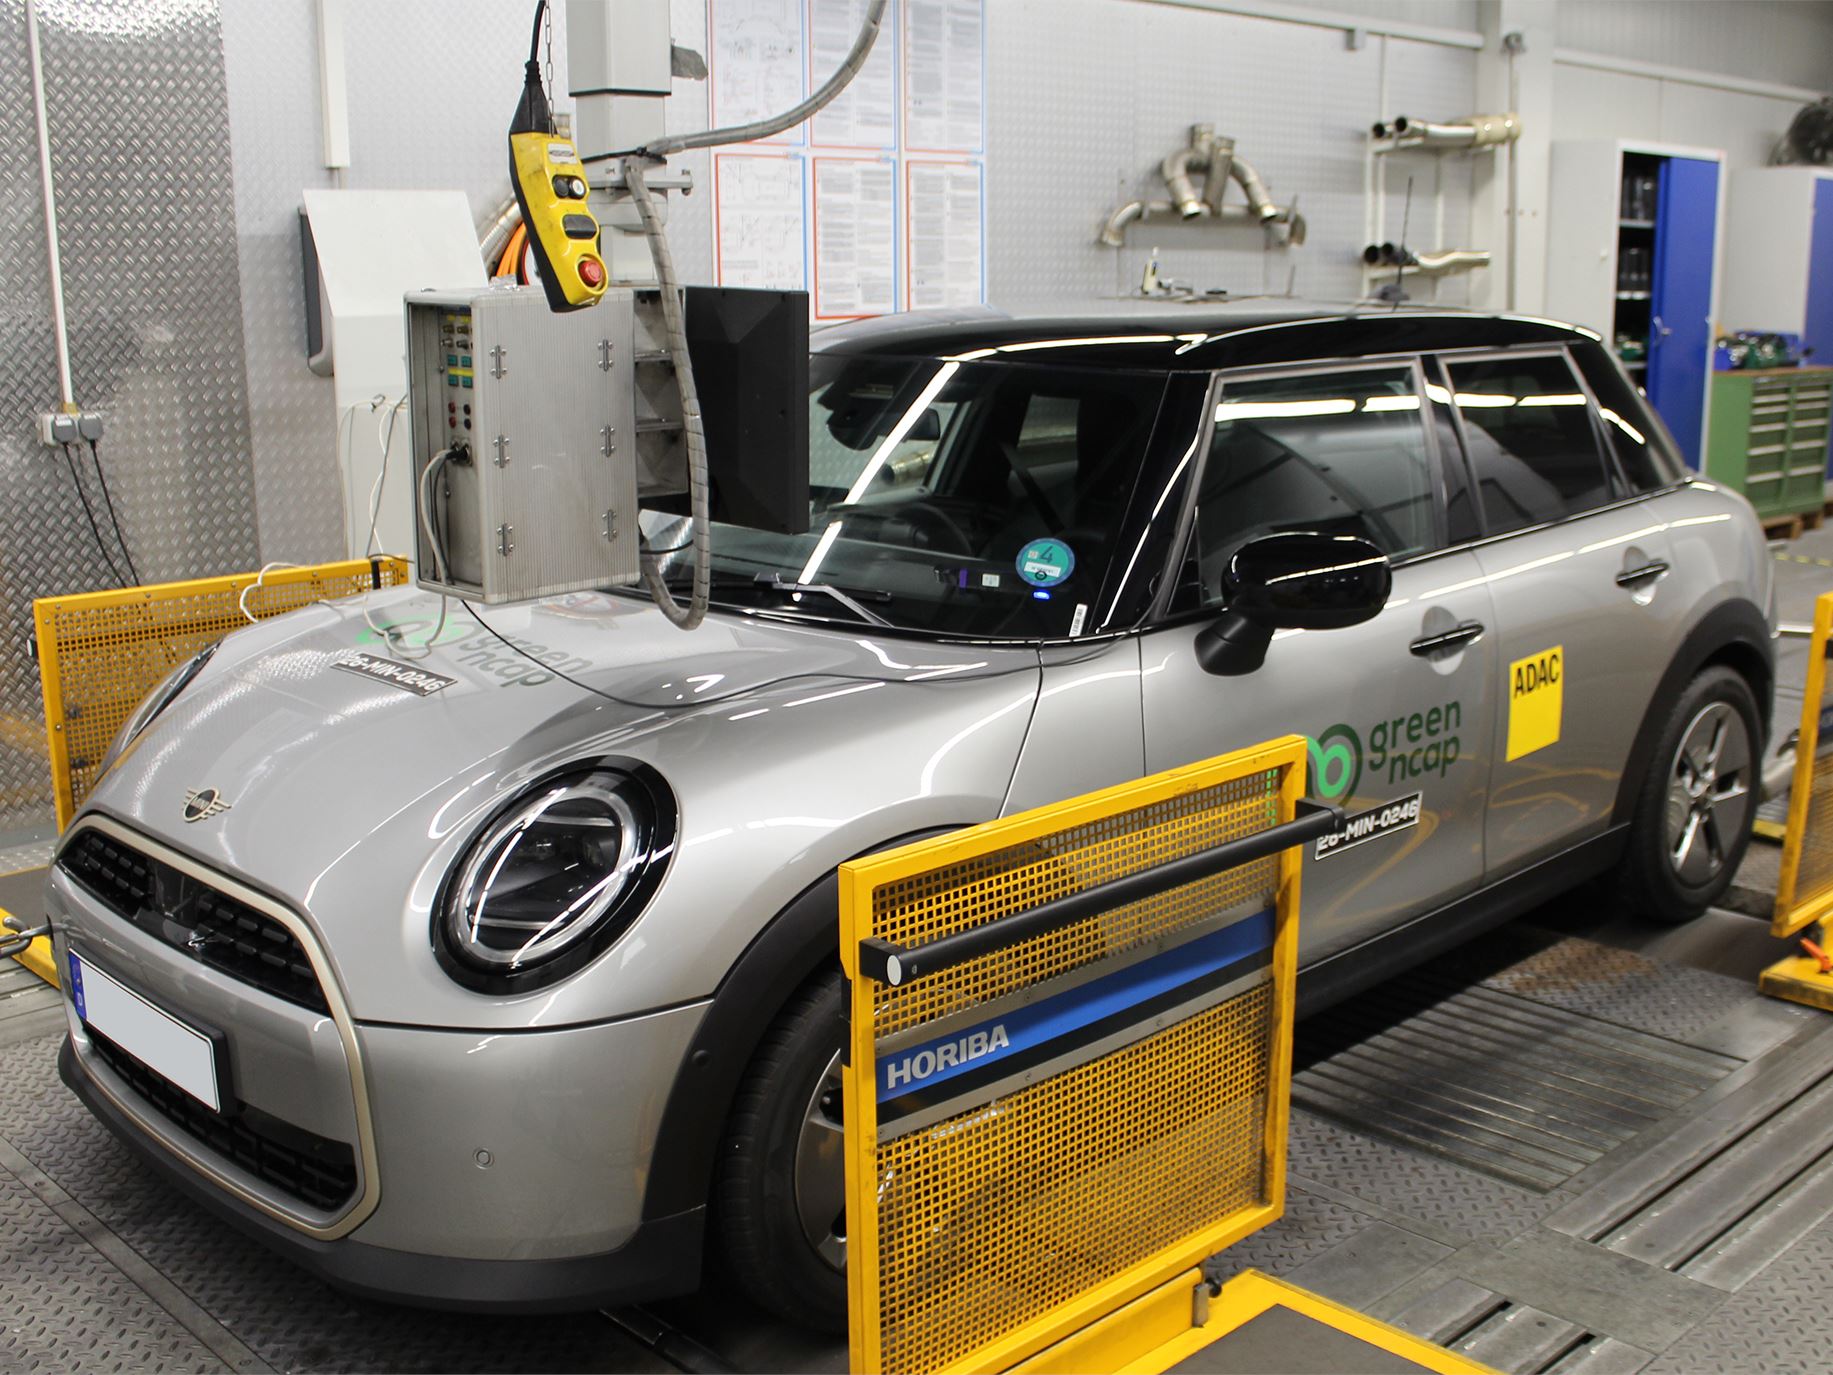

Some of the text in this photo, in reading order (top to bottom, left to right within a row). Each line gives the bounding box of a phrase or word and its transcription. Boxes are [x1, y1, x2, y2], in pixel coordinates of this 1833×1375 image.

[1040, 545, 1053, 563] 4
[456, 650, 556, 688] ncap
[457, 634, 594, 674] green
[1514, 654, 1560, 698] ADAC
[1369, 701, 1461, 771] green
[1388, 735, 1461, 785] ncap
[888, 1024, 1009, 1089] HORIBA
